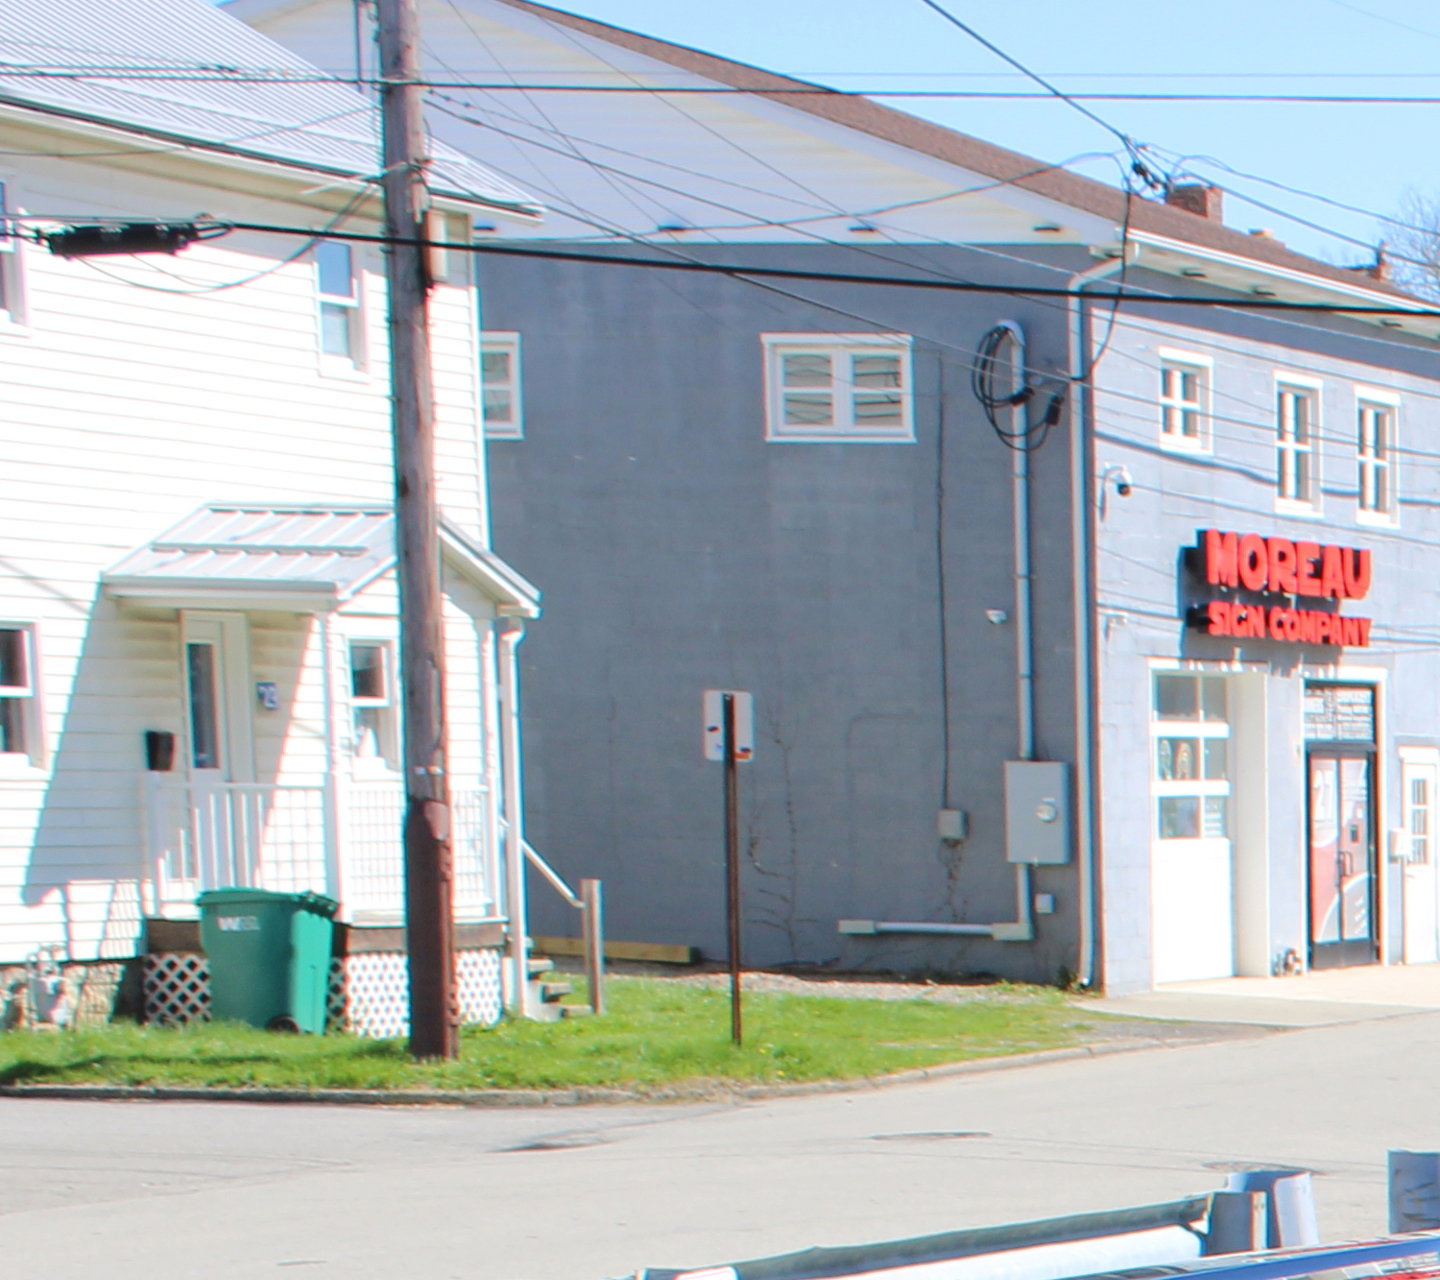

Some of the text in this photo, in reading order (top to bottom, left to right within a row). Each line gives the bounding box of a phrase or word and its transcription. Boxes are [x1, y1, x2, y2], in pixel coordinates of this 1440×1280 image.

[1206, 529, 1371, 599] MOREAU
[1208, 601, 1371, 647] SIGN COMPANY
